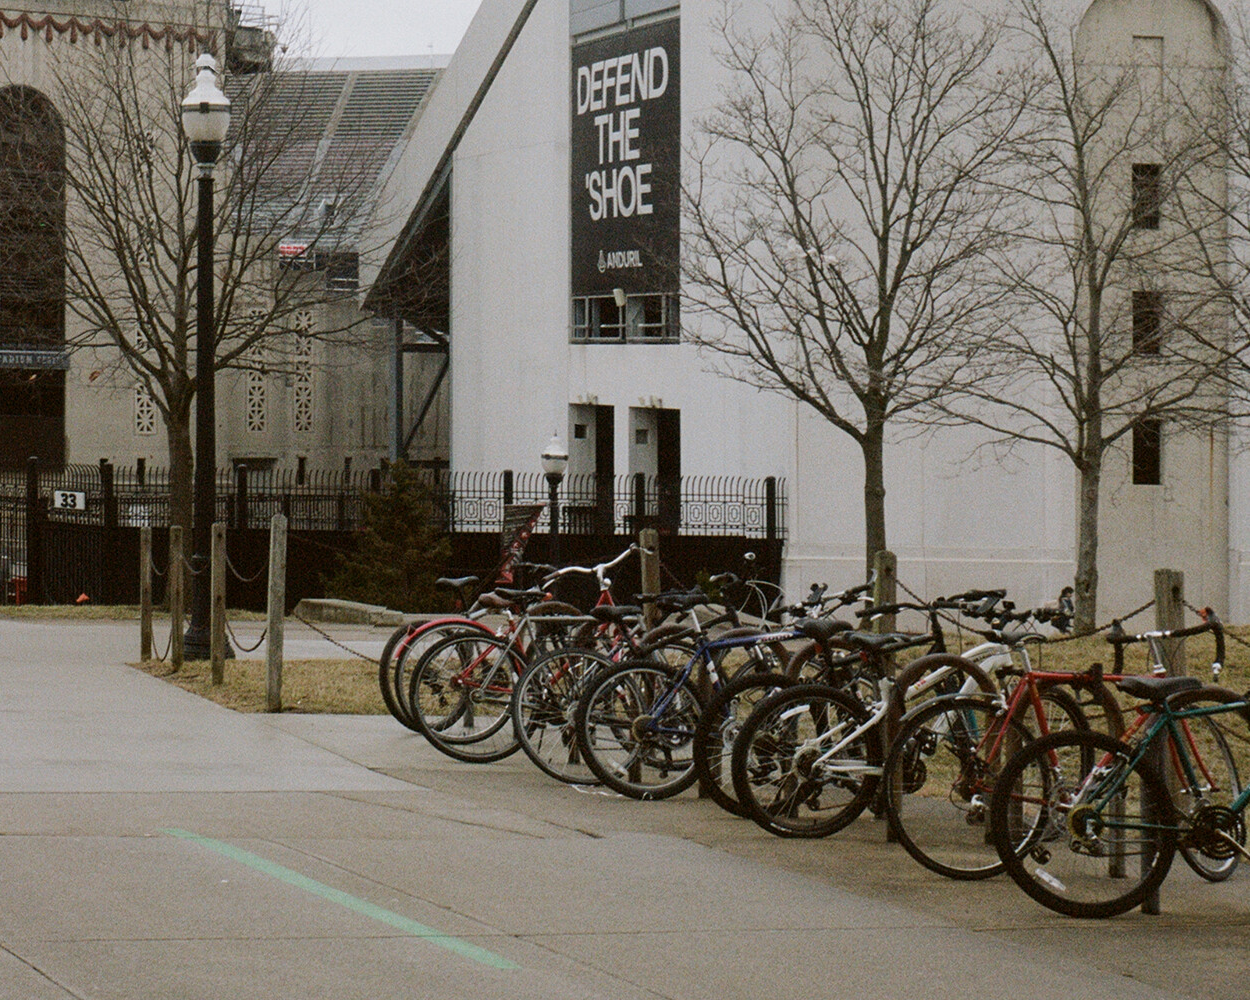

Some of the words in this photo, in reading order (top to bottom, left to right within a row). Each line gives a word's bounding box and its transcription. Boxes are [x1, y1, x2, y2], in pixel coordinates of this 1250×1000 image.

[577, 46, 669, 116] DEFEND
[594, 108, 641, 165] THE
[607, 250, 643, 269] ANDURIL
[60, 492, 77, 508] 33
